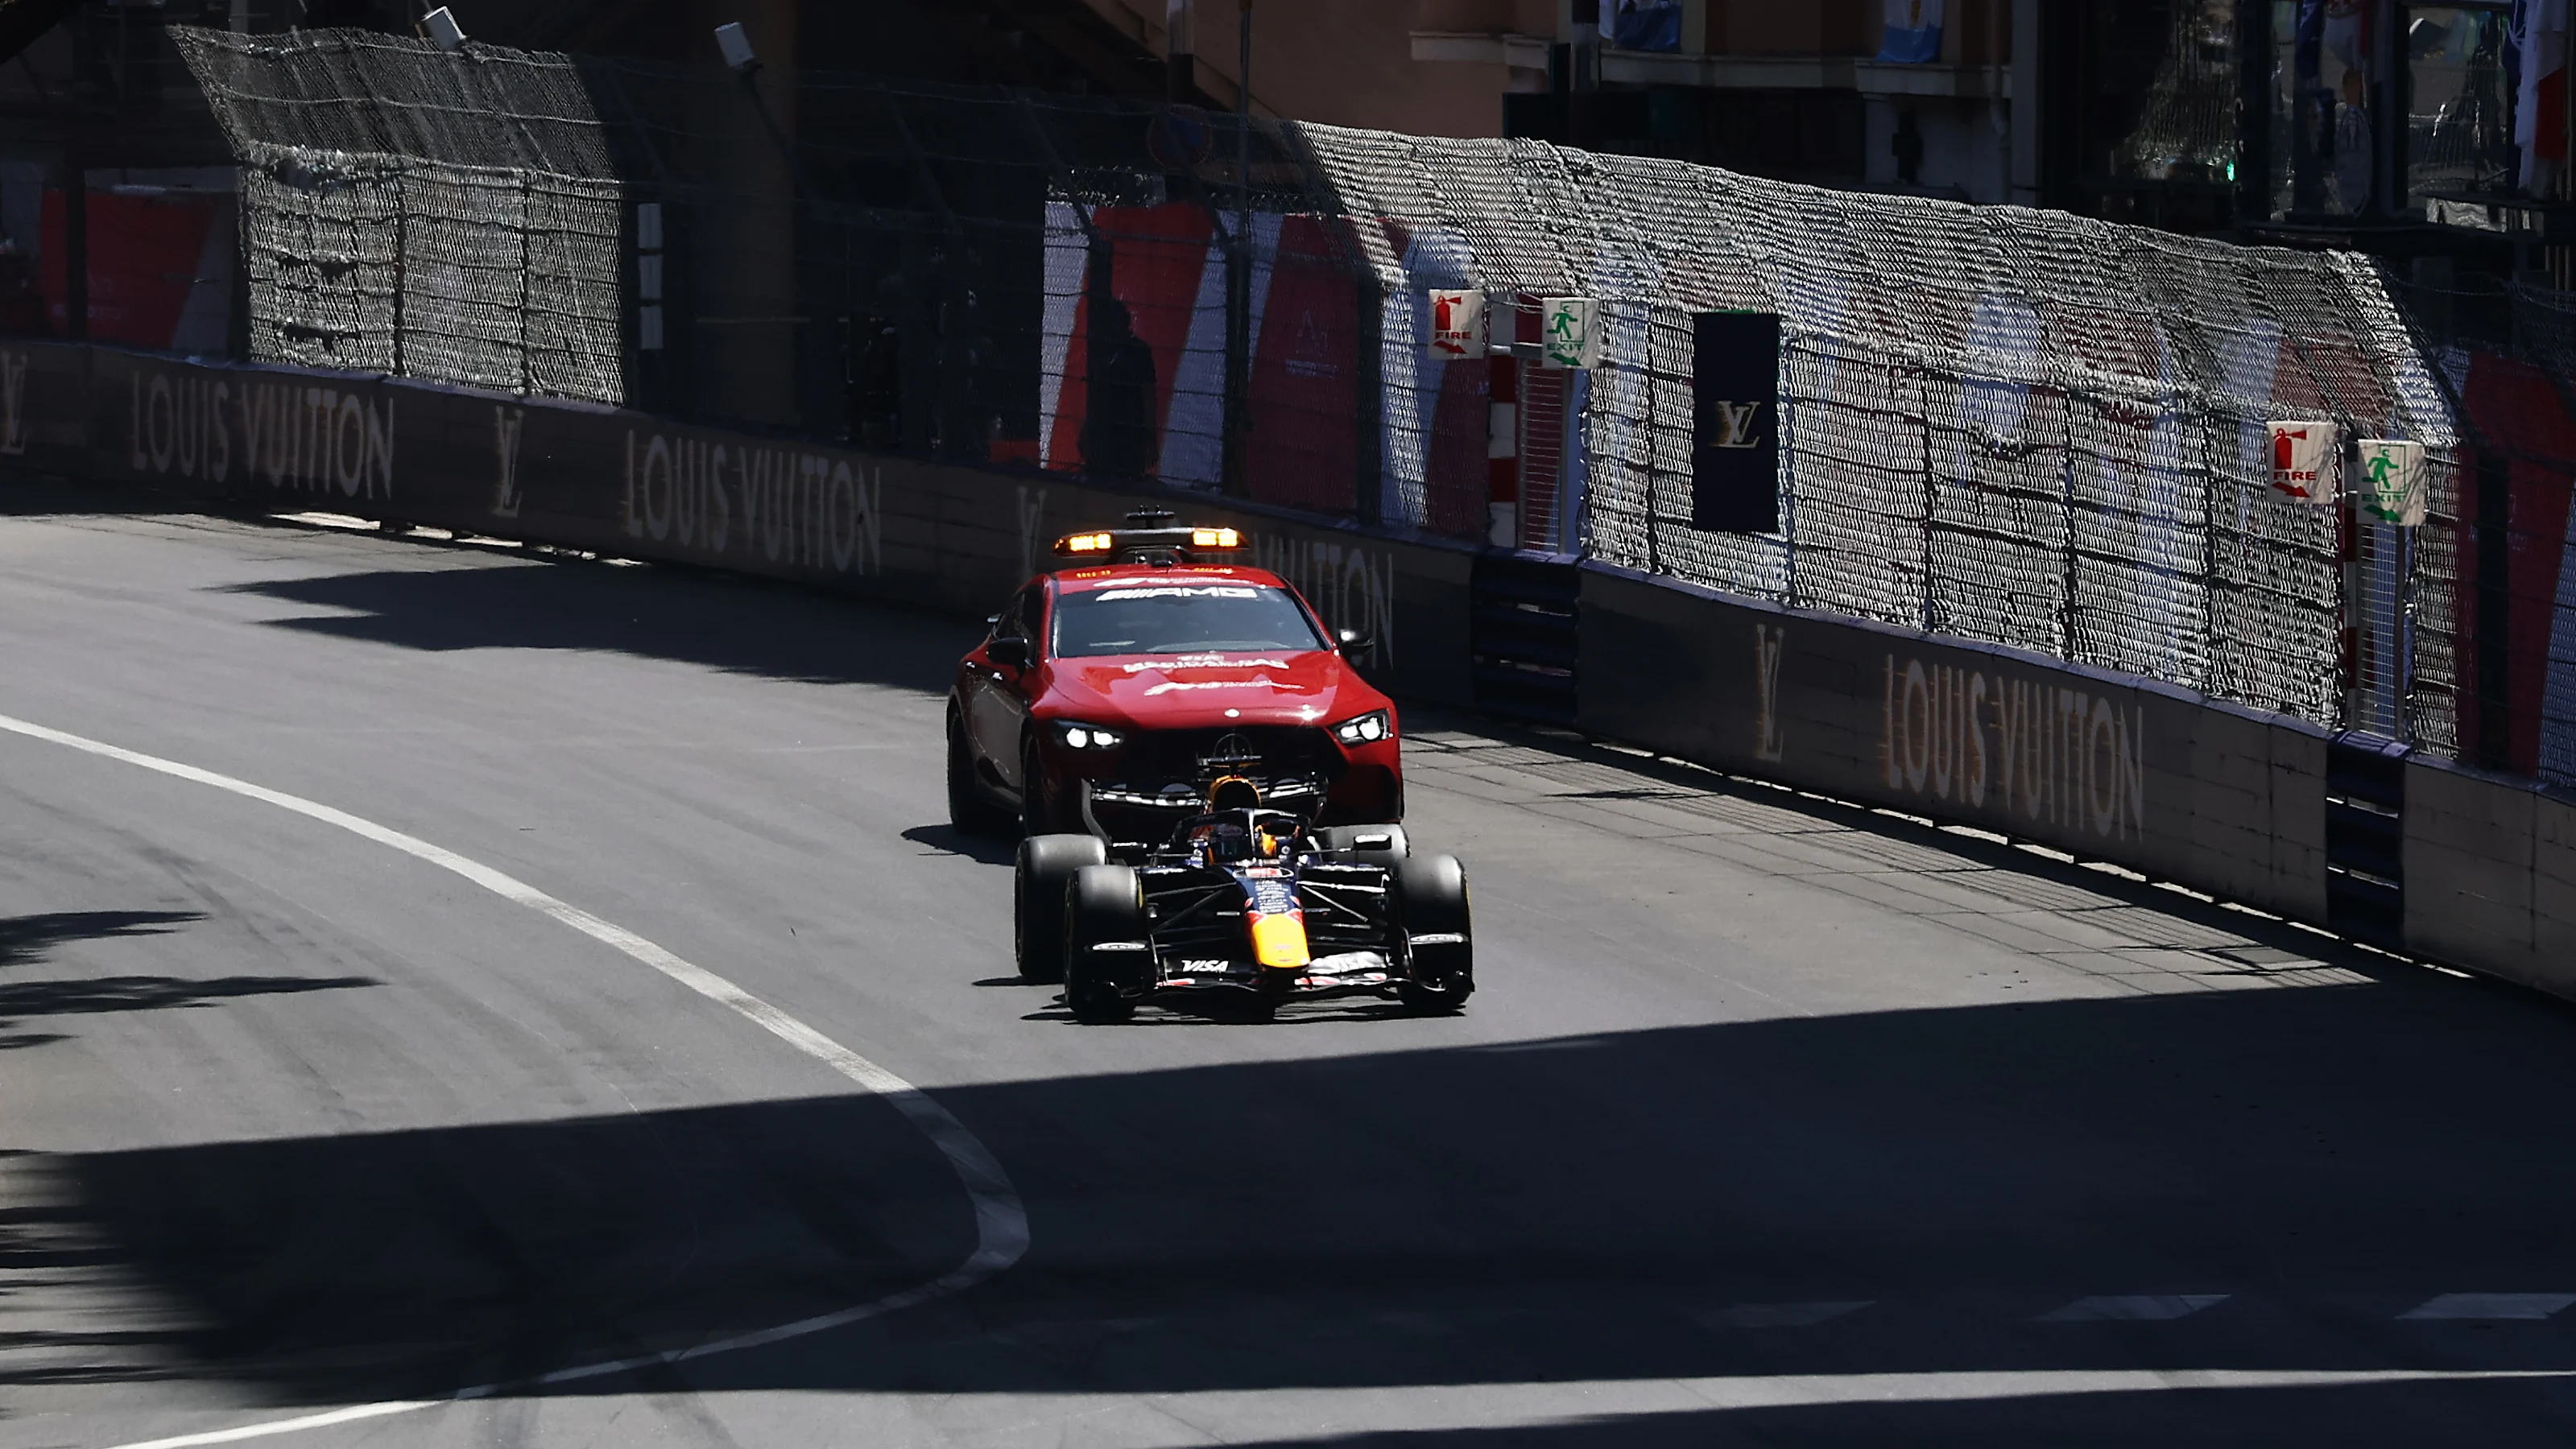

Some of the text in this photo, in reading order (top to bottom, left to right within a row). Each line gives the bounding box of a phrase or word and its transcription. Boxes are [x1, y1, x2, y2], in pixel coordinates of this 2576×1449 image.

[1435, 331, 1471, 341] FIRE
[1546, 343, 1585, 351] EXIT
[133, 370, 395, 502] LOUIS VUITTON
[2273, 471, 2317, 481] FIRE
[628, 429, 882, 577] LOUIS VUITTON
[2361, 493, 2405, 503] EXIT
[1147, 587, 1258, 599] AMG
[1885, 653, 2144, 844] LOUIS VUITTON
[1180, 960, 1230, 972] VISA
